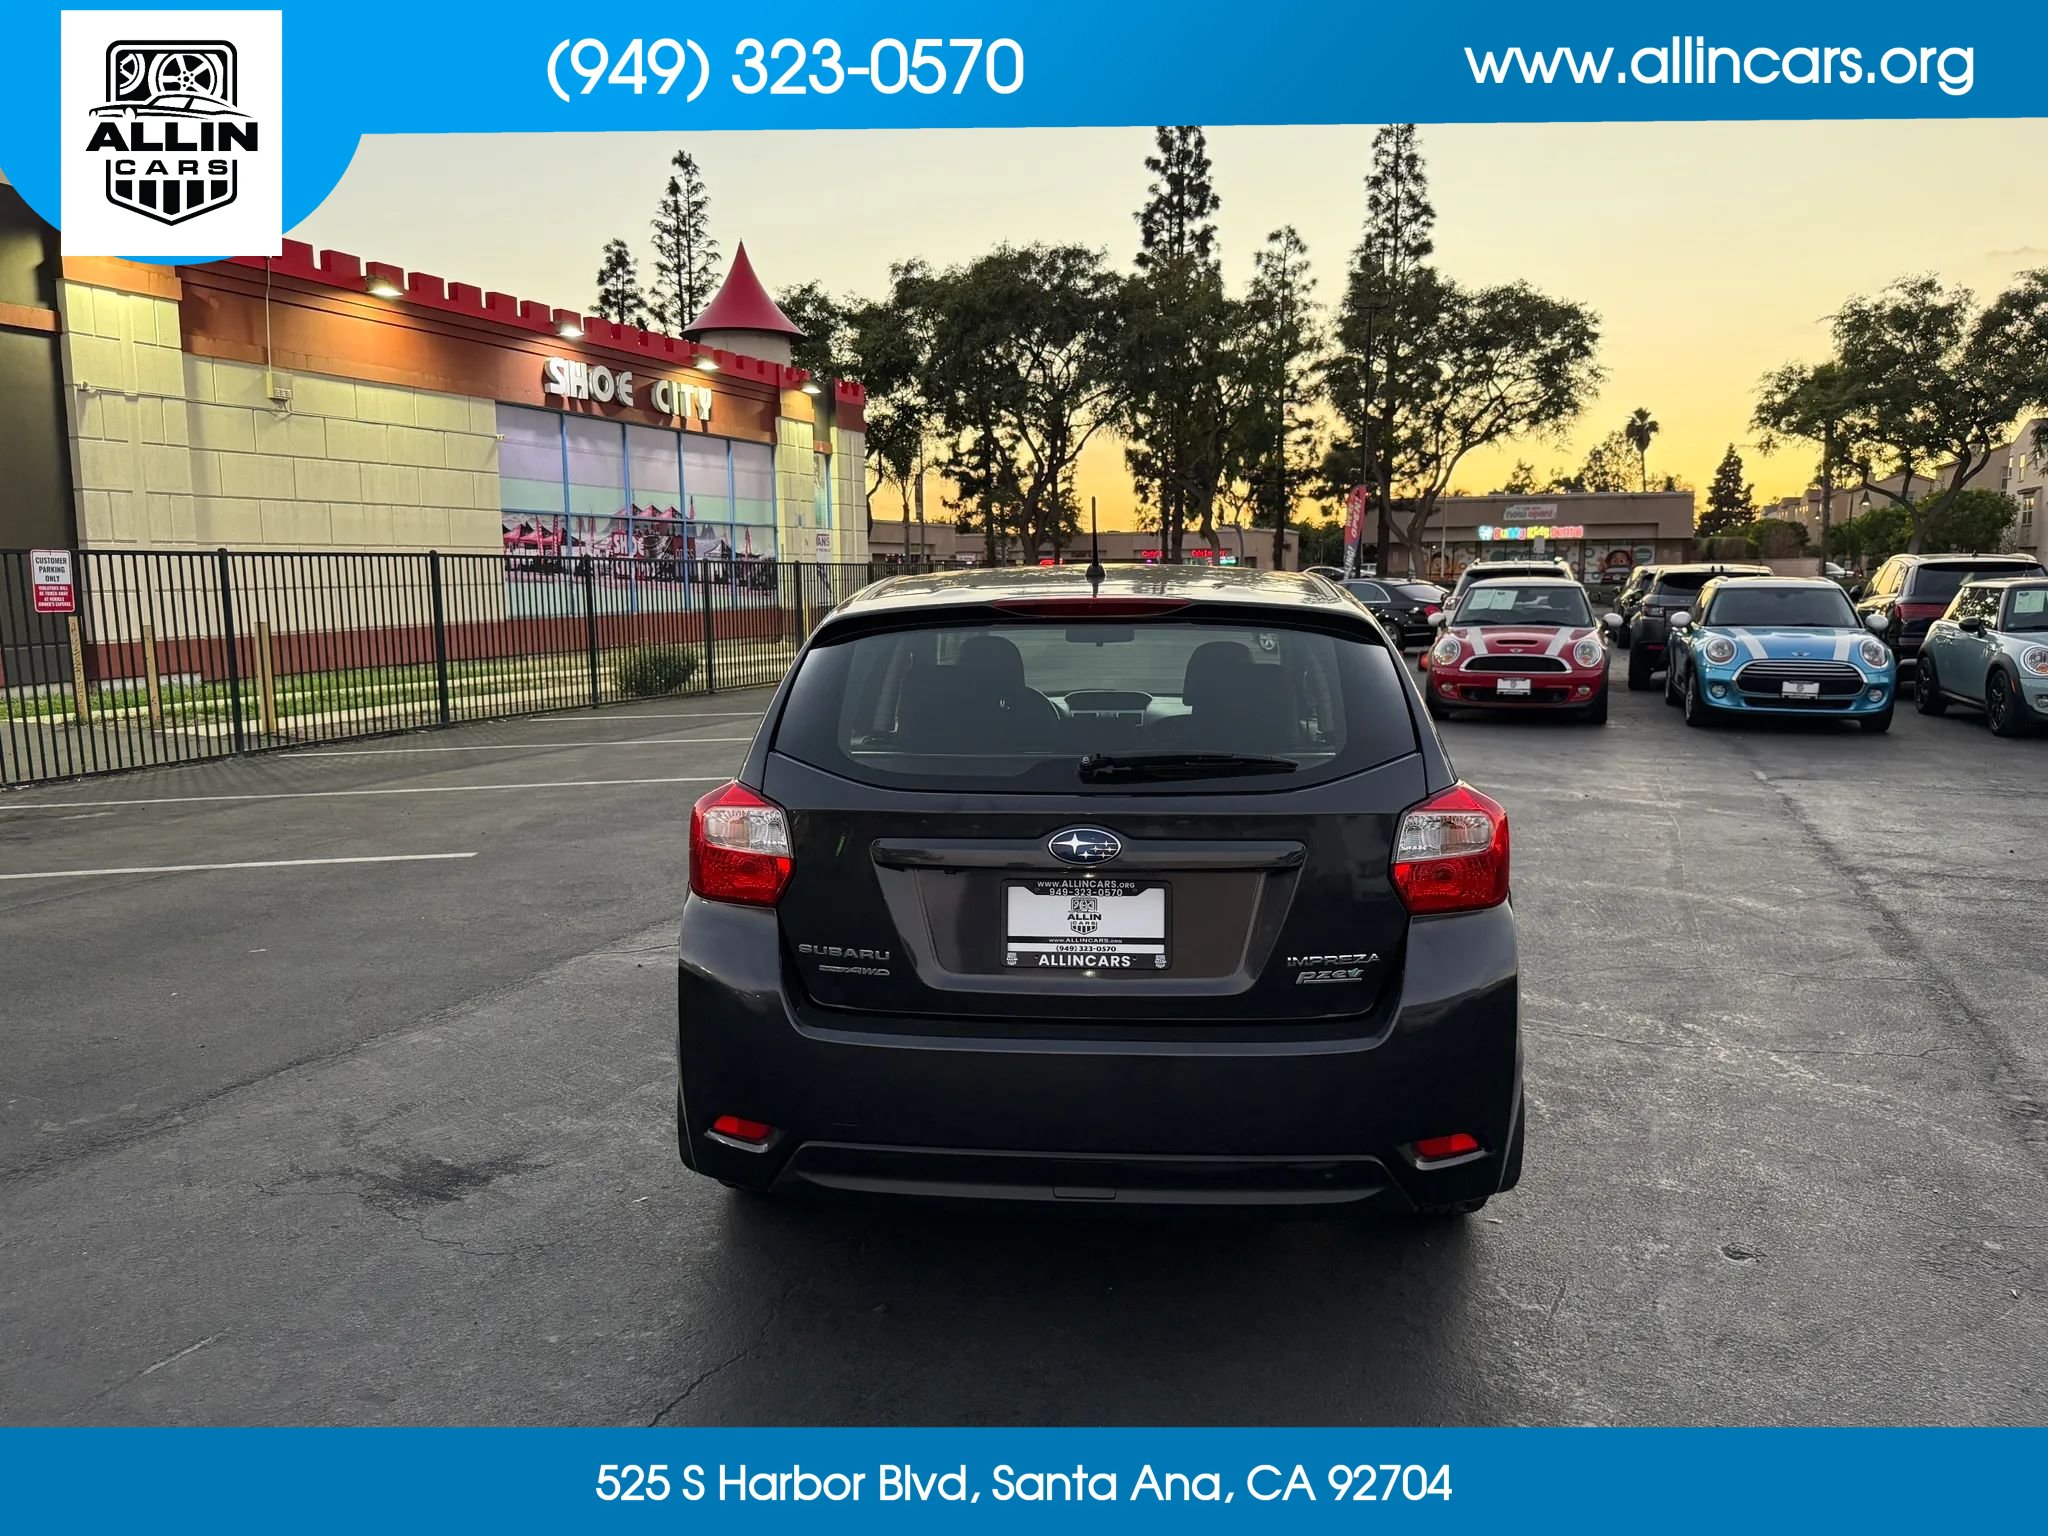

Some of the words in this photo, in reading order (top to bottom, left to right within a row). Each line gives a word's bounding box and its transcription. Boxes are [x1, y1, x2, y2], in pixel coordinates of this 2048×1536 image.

[544, 357, 634, 407] SHOE
[651, 379, 713, 421] CITY
[1049, 888, 1123, 897] 949-323-0570
[798, 943, 890, 960] SUBARU
[1056, 945, 1078, 953] (949)
[1038, 954, 1131, 967] ALLINCARS
[1287, 953, 1381, 967] IMPREZA
